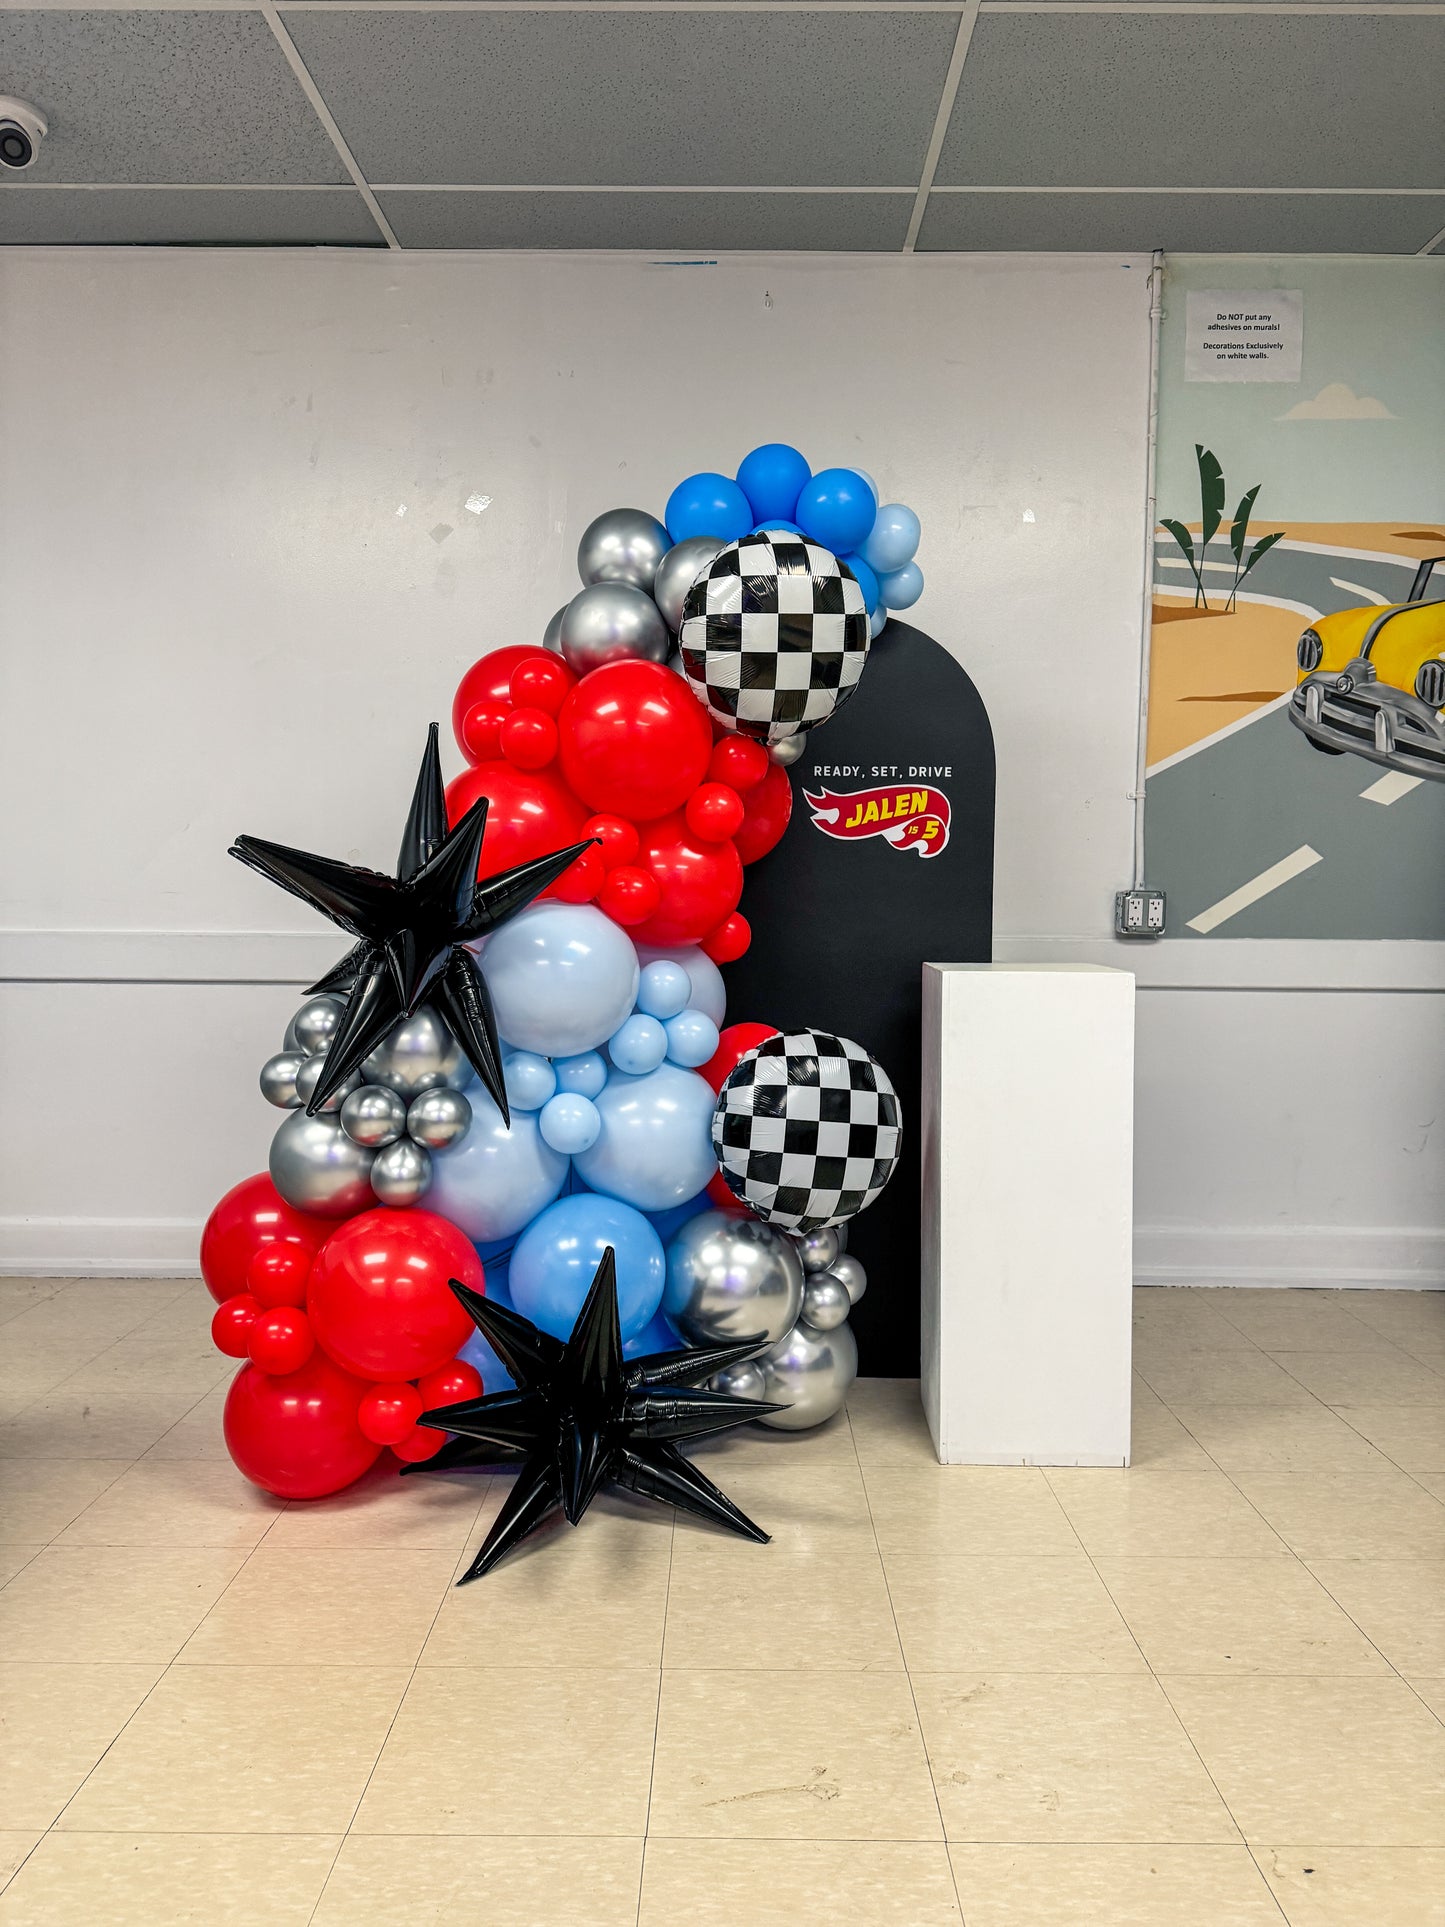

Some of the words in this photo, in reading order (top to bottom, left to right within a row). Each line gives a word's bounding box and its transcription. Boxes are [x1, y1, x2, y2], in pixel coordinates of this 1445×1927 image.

[1246, 342, 1284, 350] Exclusively
[814, 765, 866, 779] READY,
[871, 766, 903, 779] SET,
[908, 766, 953, 777] DRIVE
[845, 790, 928, 829] JALEN
[908, 825, 919, 834] IS
[921, 820, 940, 839] 5
